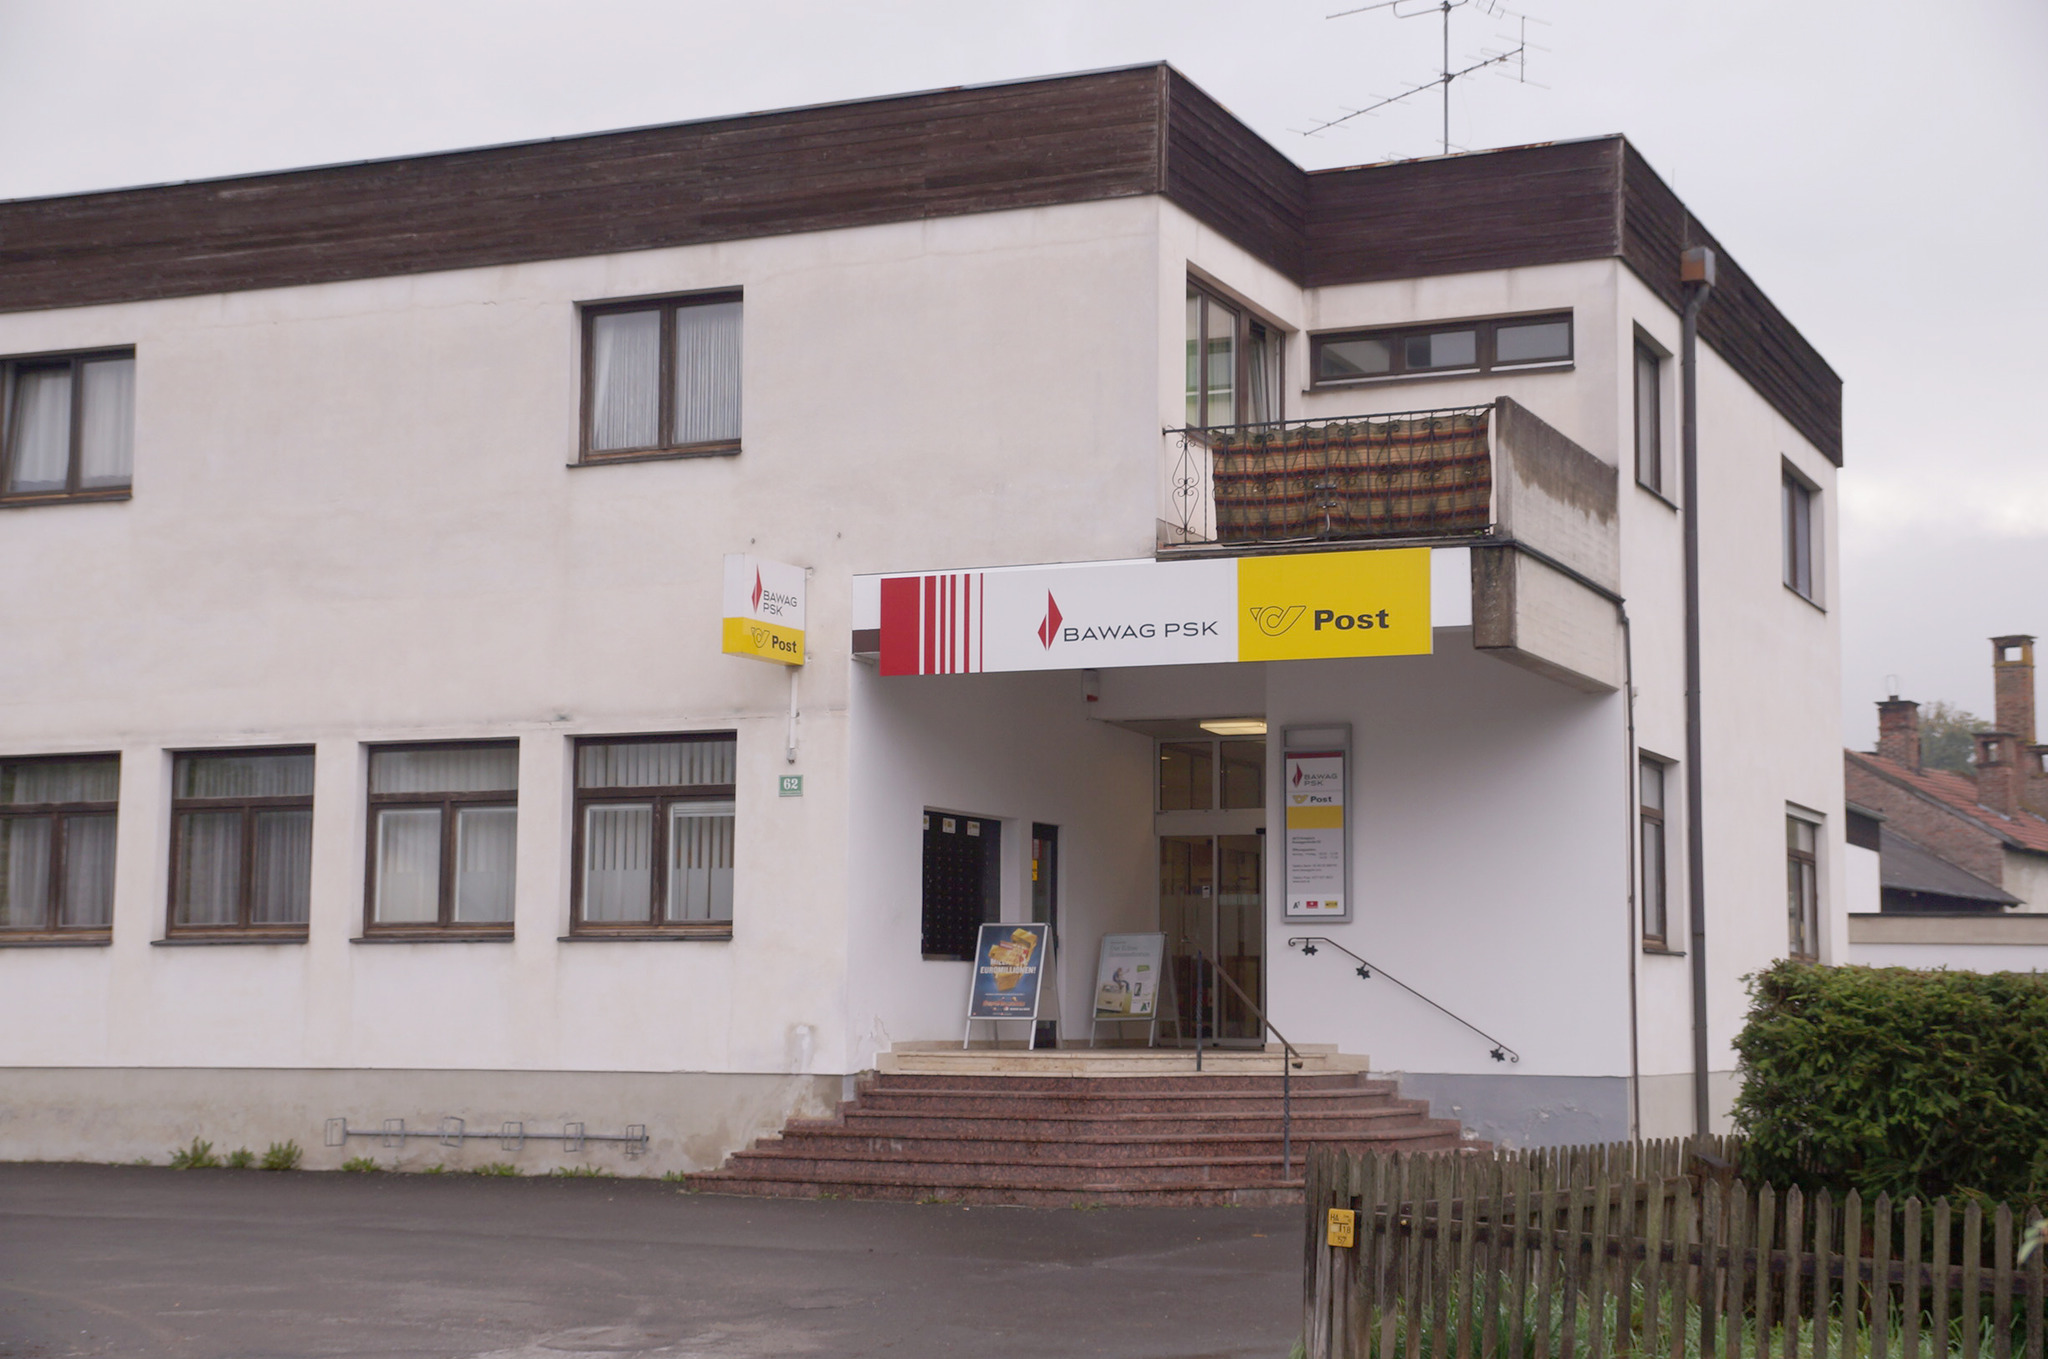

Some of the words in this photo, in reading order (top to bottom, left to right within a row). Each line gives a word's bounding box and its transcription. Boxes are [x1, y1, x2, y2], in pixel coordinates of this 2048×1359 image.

[763, 589, 798, 608] BAWAG
[763, 602, 784, 617] PSK
[1314, 608, 1390, 631] Post
[1064, 621, 1156, 643] BAWAG
[1165, 619, 1220, 639] PSK
[771, 634, 797, 654] Post
[783, 777, 799, 791] 62
[1303, 773, 1338, 781] BAWAG
[1310, 795, 1333, 803] Post
[979, 966, 1037, 975] EUROMILLIONEN!
